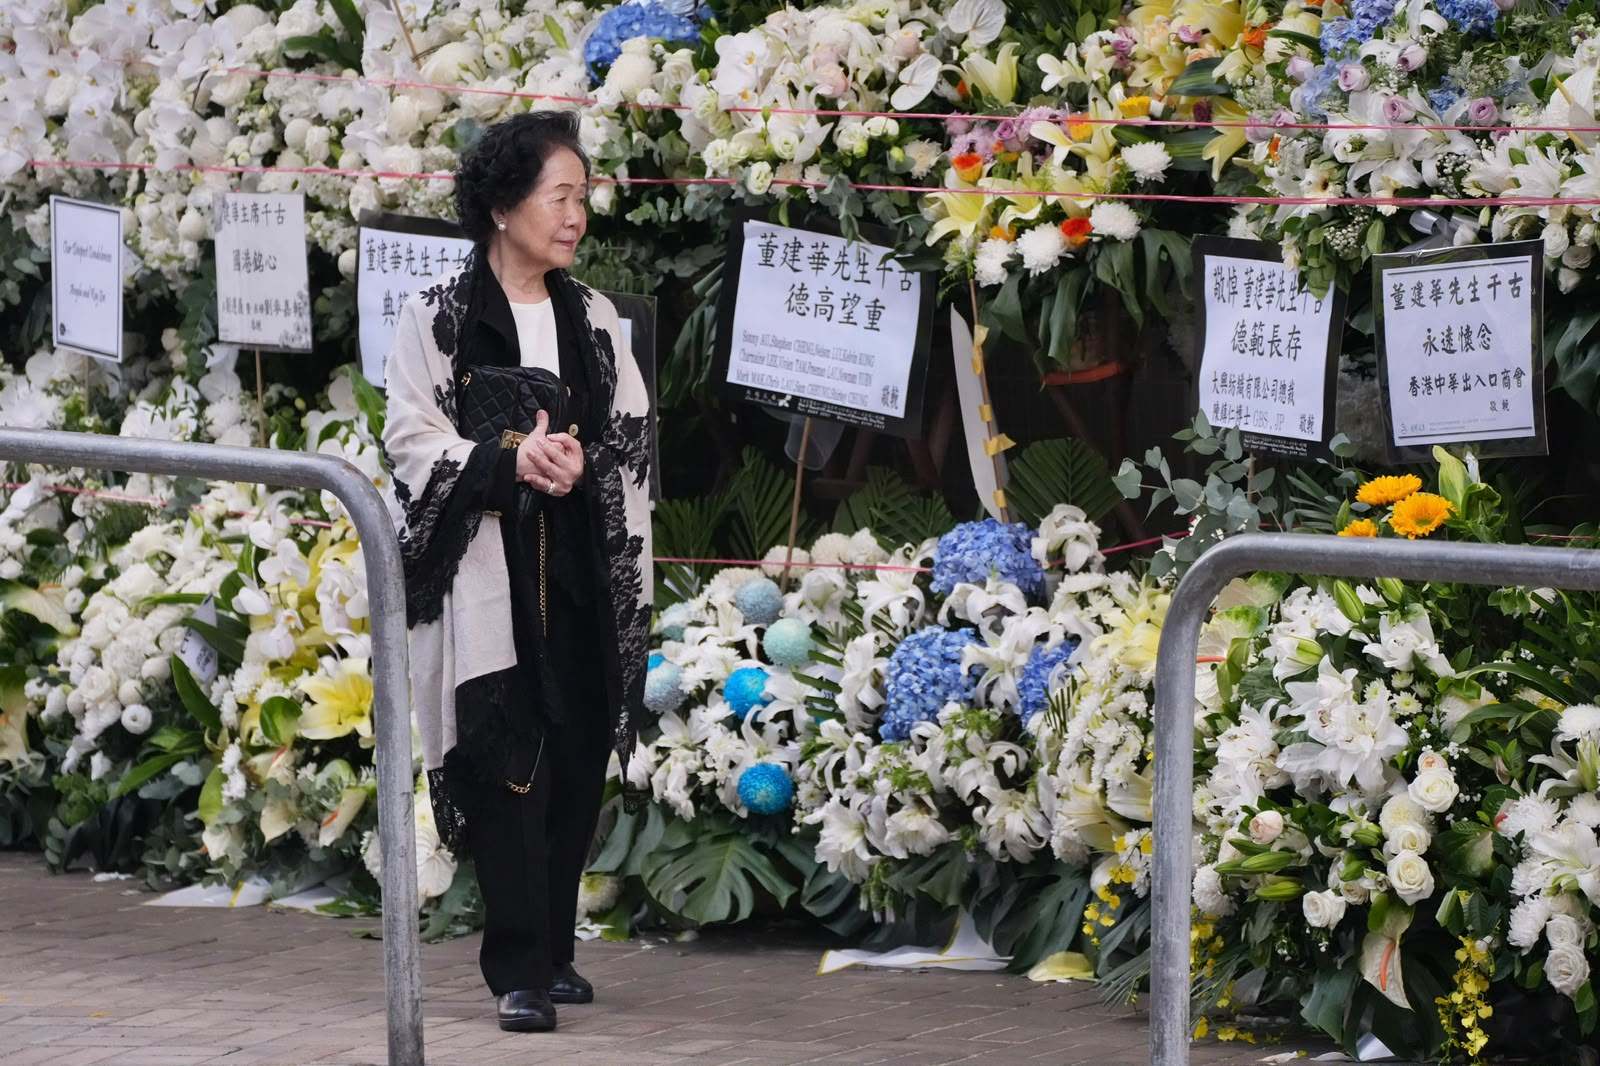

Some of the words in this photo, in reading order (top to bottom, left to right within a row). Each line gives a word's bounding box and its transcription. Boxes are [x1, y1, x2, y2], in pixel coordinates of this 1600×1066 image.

[758, 232, 915, 291] 董建華先生千古
[784, 282, 886, 332] 德高望重
[1390, 272, 1523, 311] 董建華先生千古
[1232, 320, 1302, 361] 德範長存
[1422, 322, 1493, 357] 永遠懷念
[1408, 366, 1526, 397] 香港中華出入口商會
